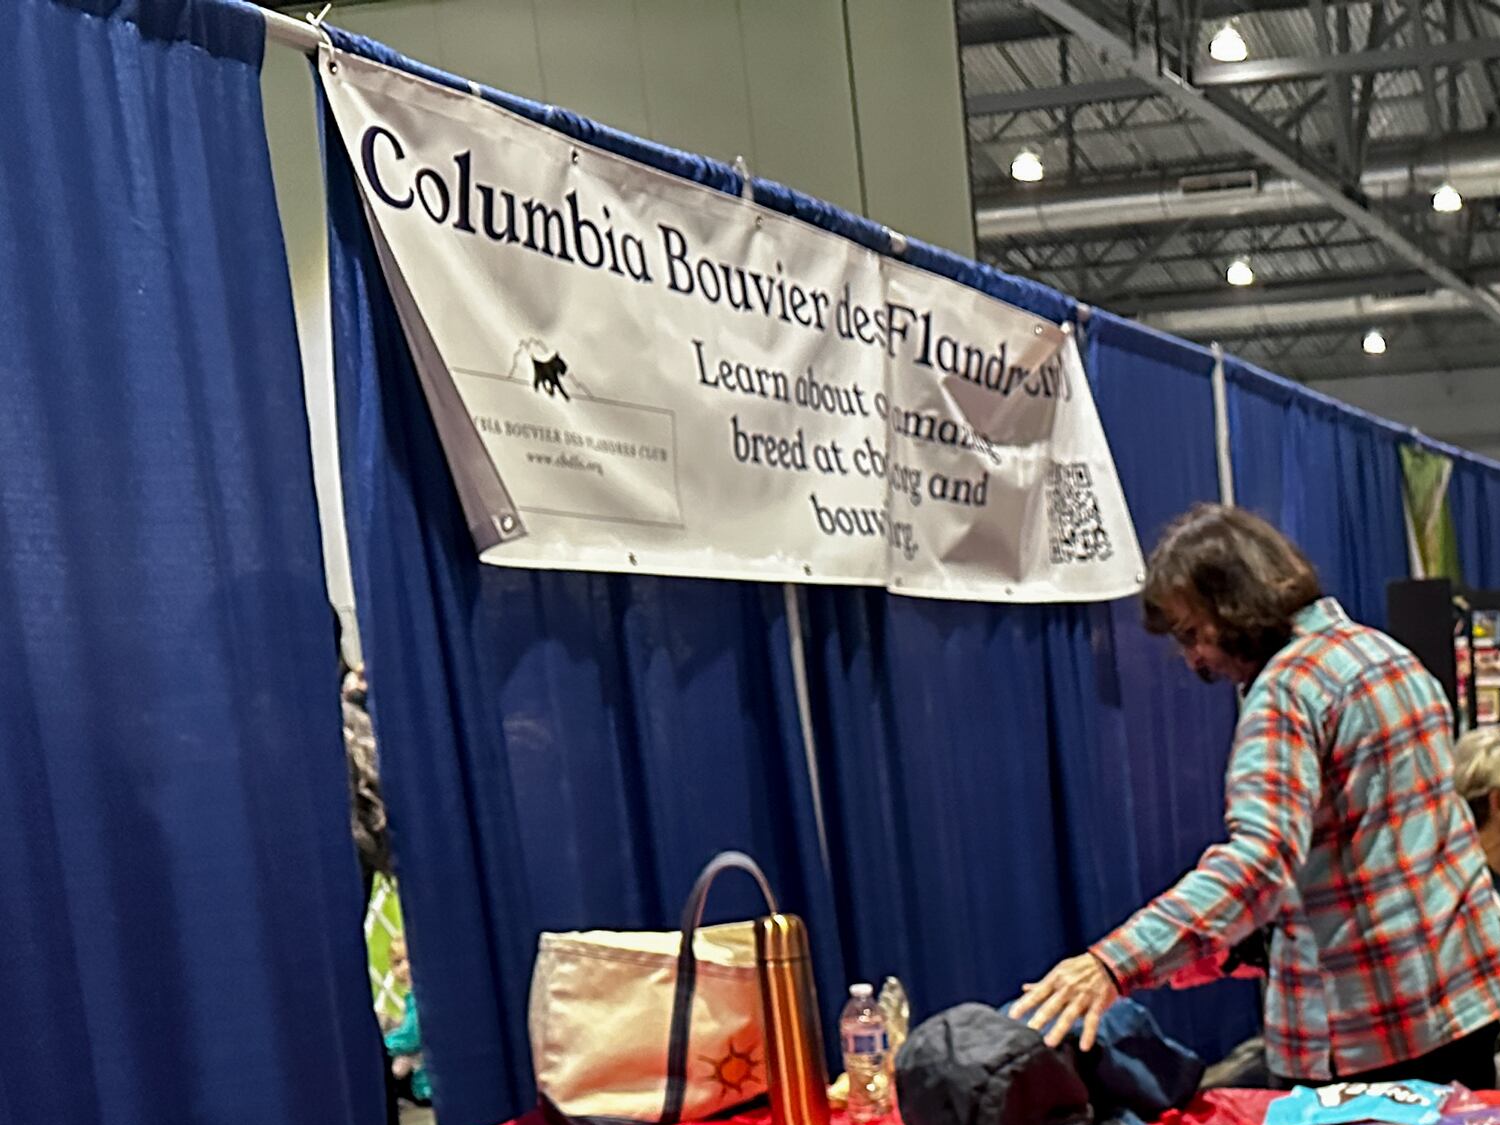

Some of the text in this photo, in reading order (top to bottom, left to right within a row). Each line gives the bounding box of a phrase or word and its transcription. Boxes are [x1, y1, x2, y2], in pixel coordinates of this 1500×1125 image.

[360, 124, 653, 283] Columbia
[657, 223, 829, 331] Bouvier
[692, 339, 790, 403] Learn
[795, 365, 869, 417] about
[731, 415, 808, 471] breed
[813, 439, 848, 475] at
[928, 471, 990, 507] and
